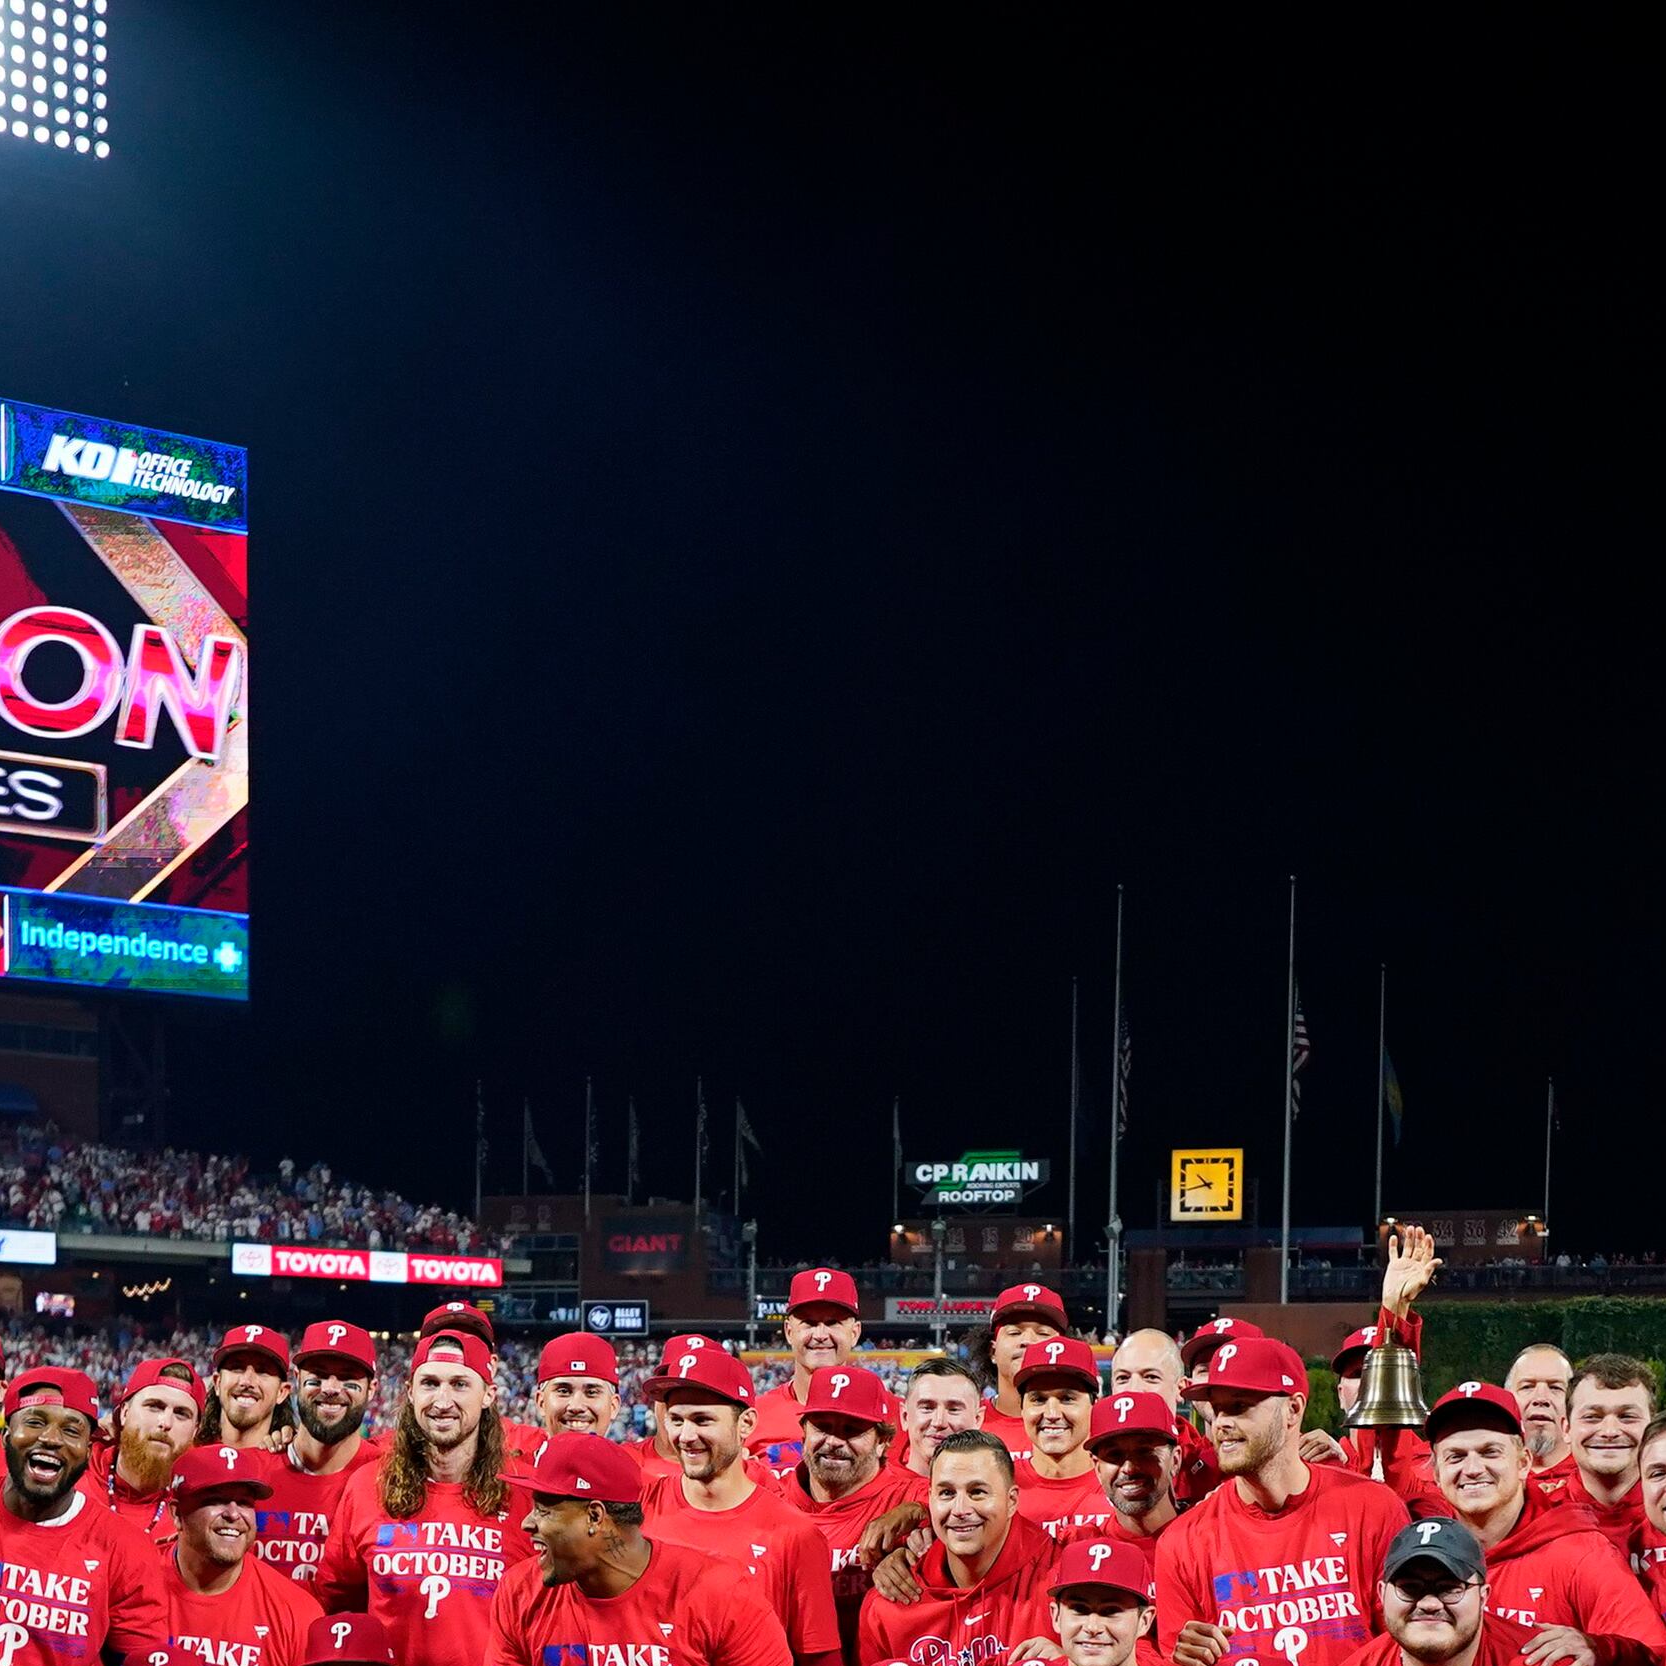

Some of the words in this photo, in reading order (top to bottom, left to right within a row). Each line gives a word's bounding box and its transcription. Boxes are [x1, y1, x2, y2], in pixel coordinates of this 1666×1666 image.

[137, 452, 193, 478] OFFICE
[133, 469, 235, 505] TECHNOLOGY
[21, 919, 209, 964] Independence
[916, 1163, 949, 1183] CP
[952, 1161, 1039, 1182] RANKIN
[938, 1190, 1015, 1202] ROOFTOP
[609, 1235, 682, 1254] GIANT
[275, 1251, 367, 1276] TOYOTA
[411, 1258, 499, 1283] TOYOTA
[422, 1523, 501, 1552] TAKE
[374, 1552, 504, 1580] OCTOBER
[1259, 1557, 1348, 1593] TAKE
[3, 1563, 90, 1605] TAKE
[419, 1575, 451, 1620] P
[1219, 1592, 1361, 1633] OCTOBER
